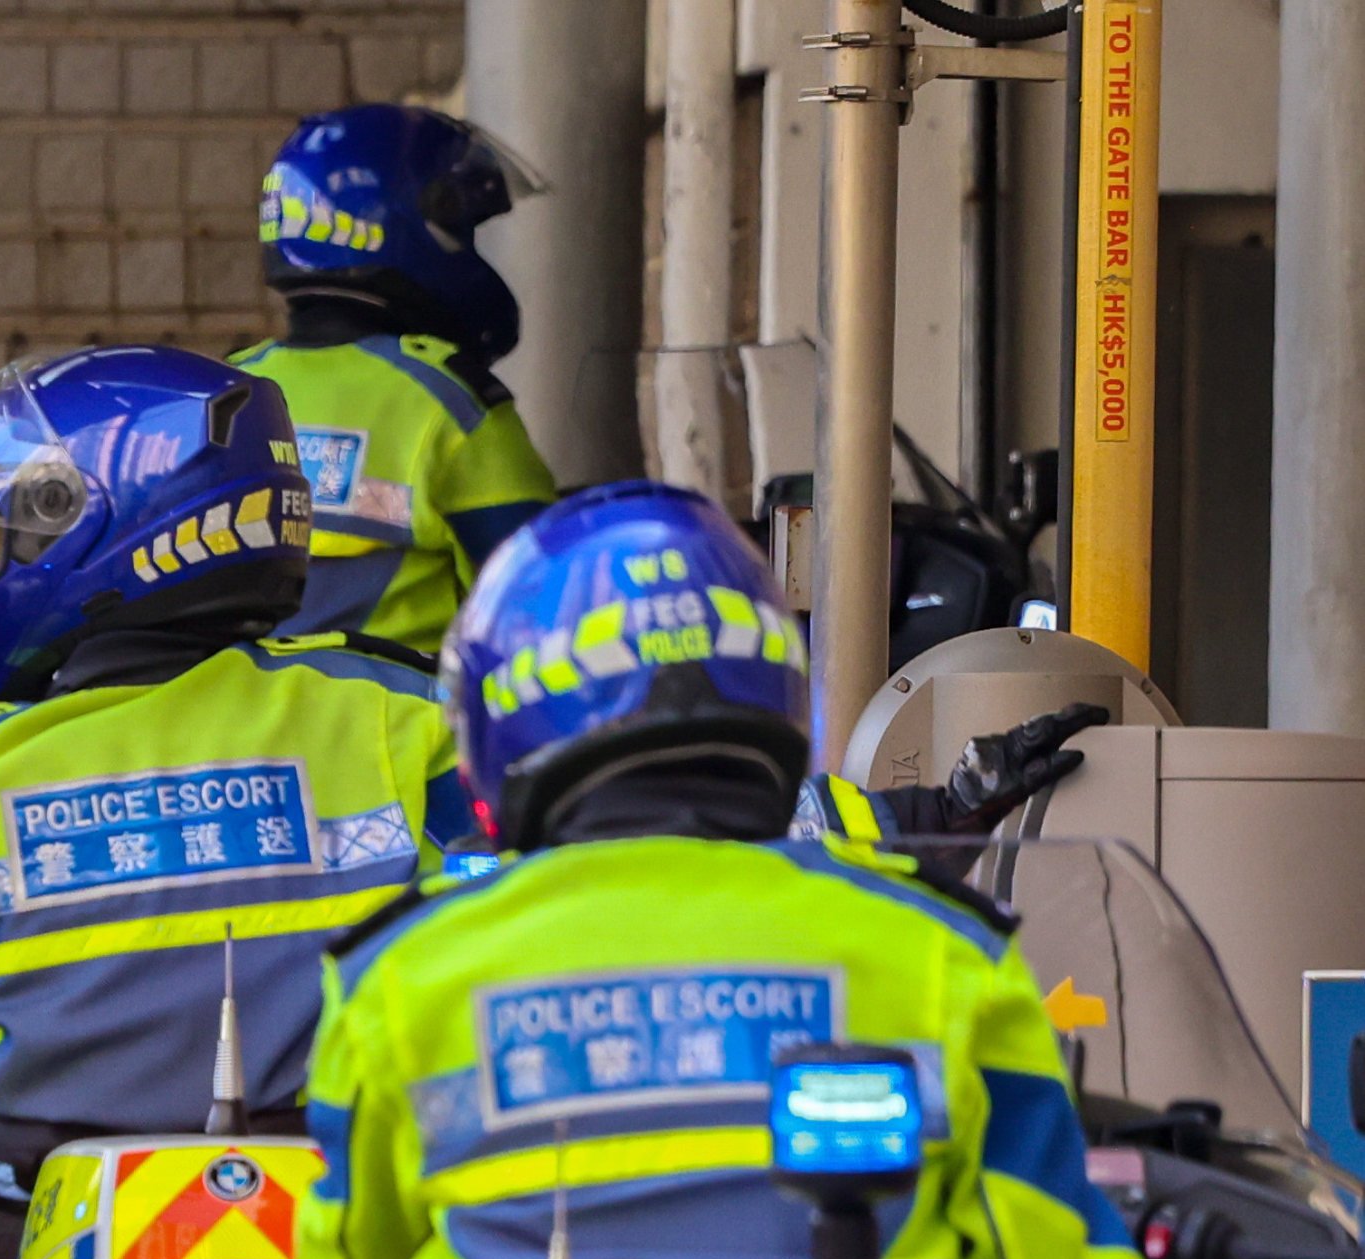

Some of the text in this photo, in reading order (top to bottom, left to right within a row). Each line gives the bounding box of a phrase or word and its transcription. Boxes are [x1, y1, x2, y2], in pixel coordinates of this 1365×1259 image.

[1098, 14, 1131, 432] TO THE GATE BAR HK$5,000
[637, 623, 713, 667] POLICE
[23, 774, 290, 835] POLICE ESCORT
[496, 979, 818, 1041] POLICE ESCORT
